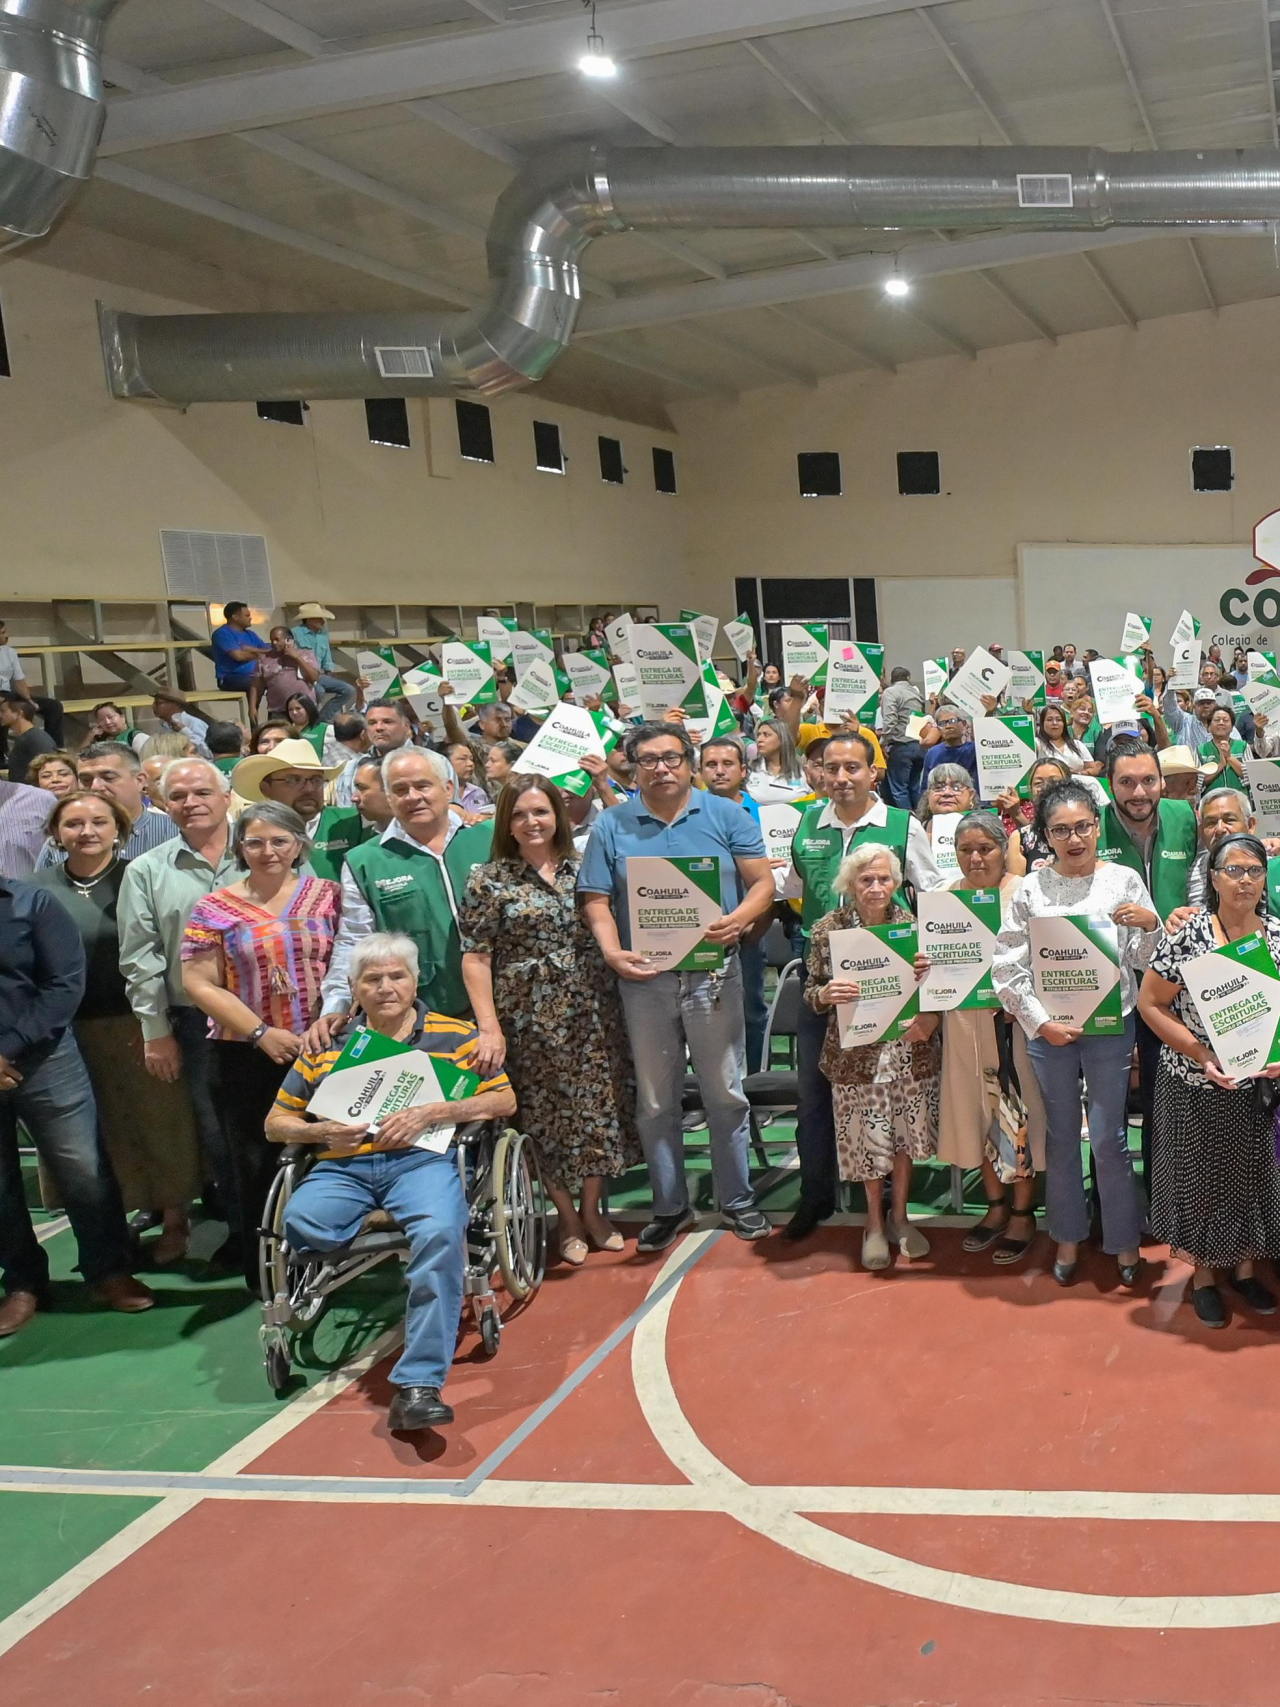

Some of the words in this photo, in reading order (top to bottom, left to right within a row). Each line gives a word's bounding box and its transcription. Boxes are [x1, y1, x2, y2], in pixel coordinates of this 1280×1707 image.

[1211, 634, 1250, 647] Colegio
[1257, 634, 1268, 645] de
[636, 649, 673, 658] COAHUILA
[551, 721, 591, 737] COAHUILA
[543, 734, 579, 749] ENTREGA
[579, 743, 589, 752] DE
[980, 738, 1014, 747] COAHUILA
[1095, 847, 1122, 857] EJORA
[636, 886, 690, 897] COAHUILA
[637, 908, 684, 916] ENTREGA
[638, 915, 700, 923] ESCRITURAS
[925, 921, 972, 933] COAHUILA
[926, 943, 967, 951] ENTREGA
[1039, 947, 1088, 959] COAHUILA
[840, 956, 890, 970] COAHUILA
[1041, 969, 1083, 978] ENTREGA
[1085, 969, 1098, 977] DE
[855, 977, 886, 986] TREGA
[887, 975, 900, 983] DE
[1041, 977, 1099, 986] ESCRITURAS
[860, 982, 901, 994] RITURAS
[1200, 975, 1249, 1002] COAHUILA
[1209, 998, 1251, 1022] ENTREGA
[1251, 991, 1266, 1004] DE
[1213, 999, 1268, 1030] ESCRITURAS
[846, 1022, 877, 1031] MEJORA
[1227, 1048, 1259, 1066] MEJORA
[347, 1069, 383, 1118] COAHUILA
[373, 1085, 402, 1125] ENTREGA
[396, 1069, 410, 1084] DE
[390, 1073, 418, 1113] RITURAS
